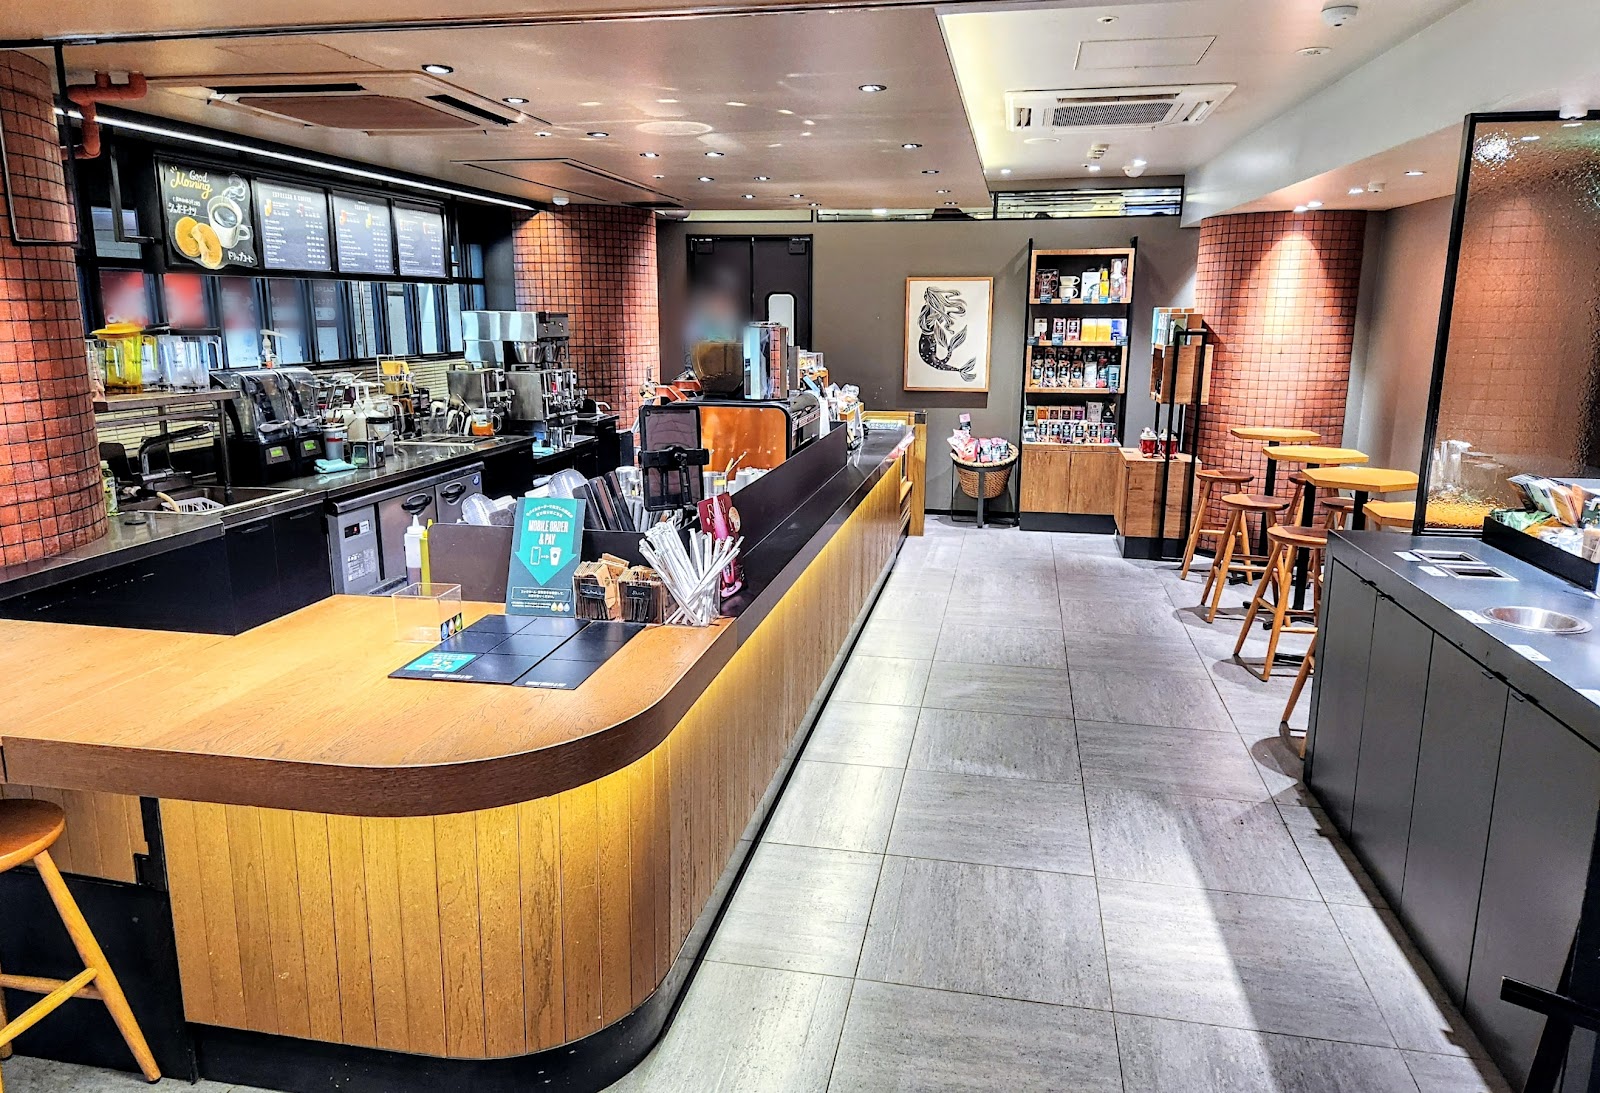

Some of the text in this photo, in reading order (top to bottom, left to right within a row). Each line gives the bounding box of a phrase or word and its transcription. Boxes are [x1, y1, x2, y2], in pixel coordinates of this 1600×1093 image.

[189, 170, 209, 183] Good
[170, 171, 213, 199] Morning
[528, 519, 569, 533] MOBILE ORDER
[538, 533, 556, 546] & PAY
